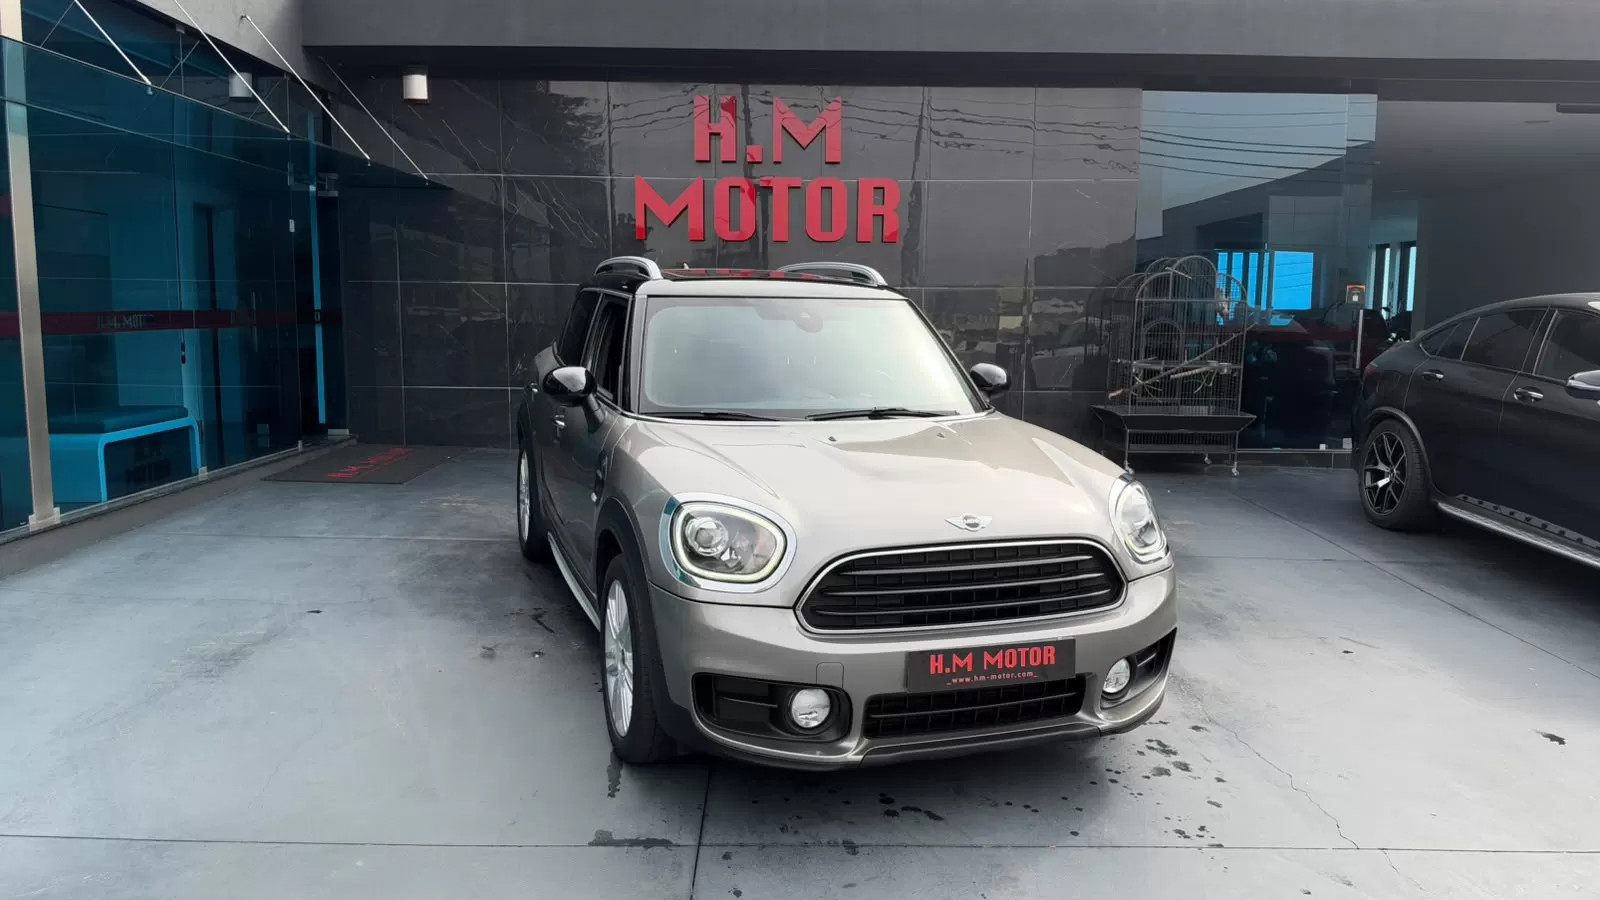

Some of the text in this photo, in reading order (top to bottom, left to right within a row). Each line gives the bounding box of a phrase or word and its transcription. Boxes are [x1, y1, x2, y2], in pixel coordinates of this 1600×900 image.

[694, 95, 842, 164] H.M
[635, 175, 900, 242] MOTOR
[929, 645, 1056, 675] H.M MOTOR
